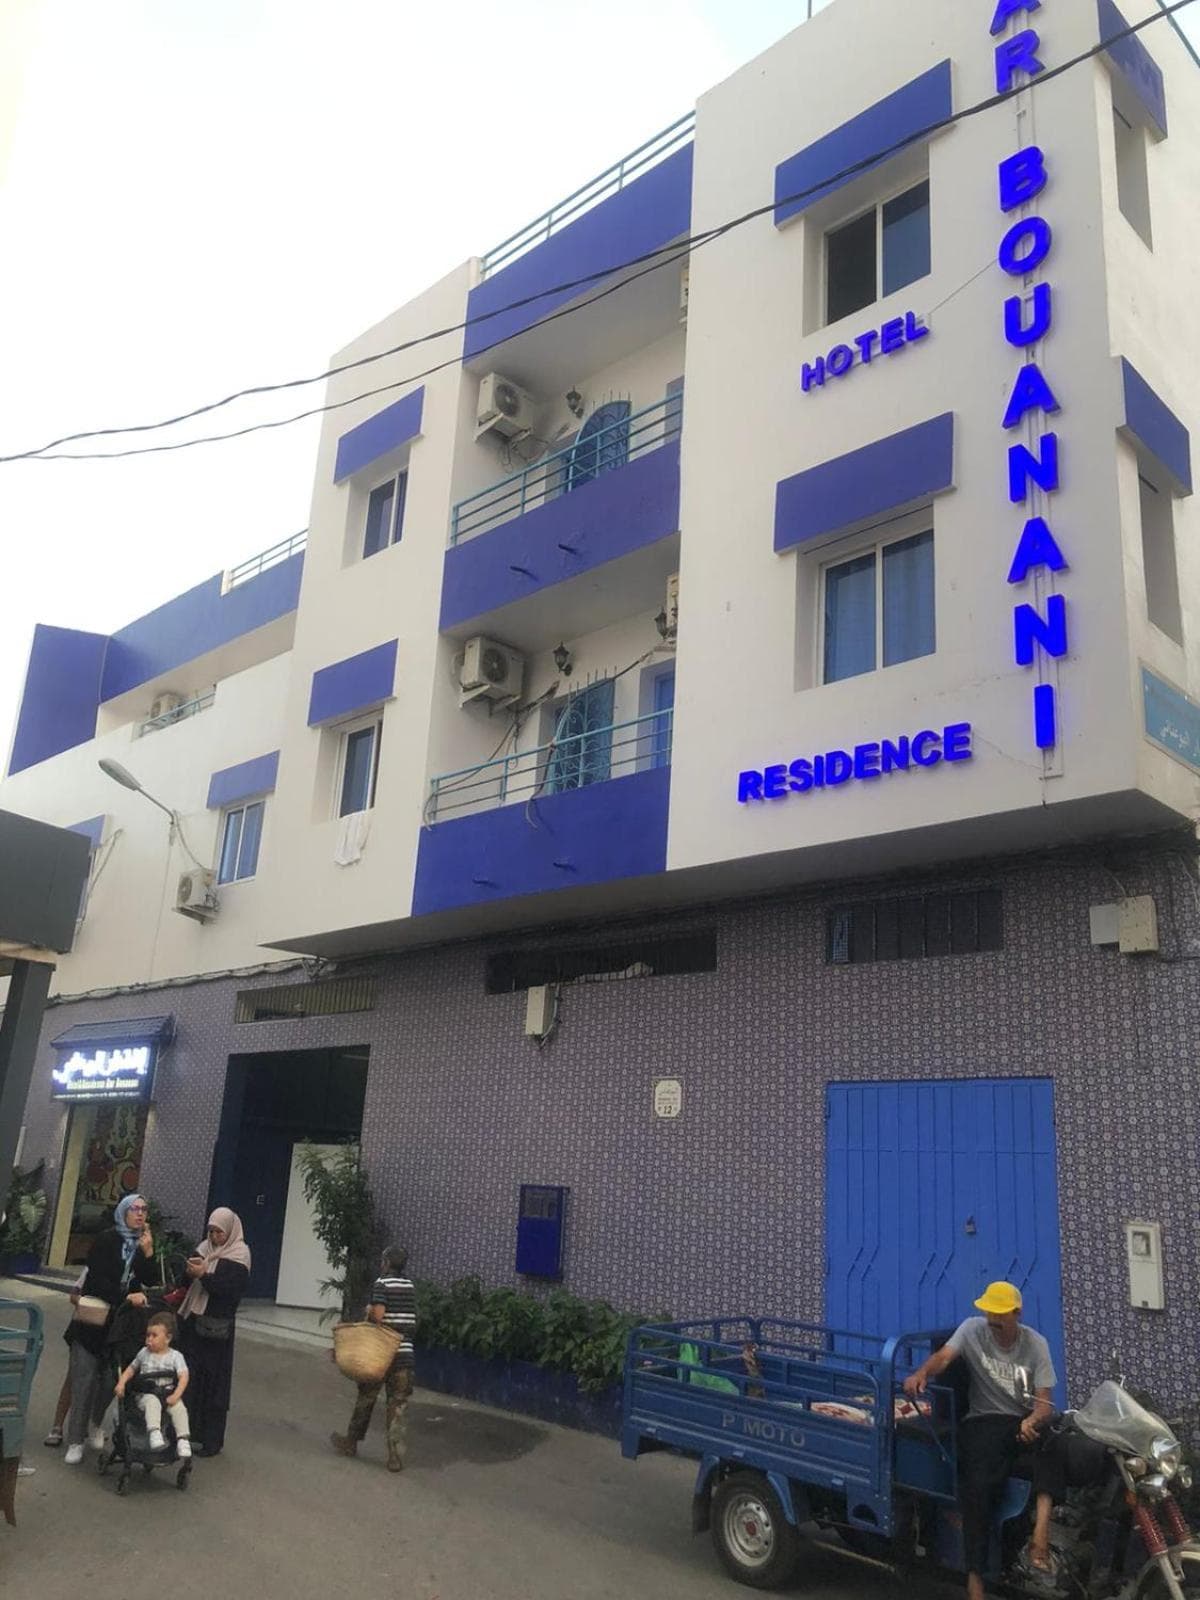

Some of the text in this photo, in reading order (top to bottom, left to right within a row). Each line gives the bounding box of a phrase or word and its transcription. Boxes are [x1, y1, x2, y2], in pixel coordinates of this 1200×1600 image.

[801, 311, 929, 392] HOTEL
[998, 146, 1069, 750] BOUANANI
[737, 722, 972, 803] RESIDENCE
[722, 1411, 806, 1448] P MOTO
